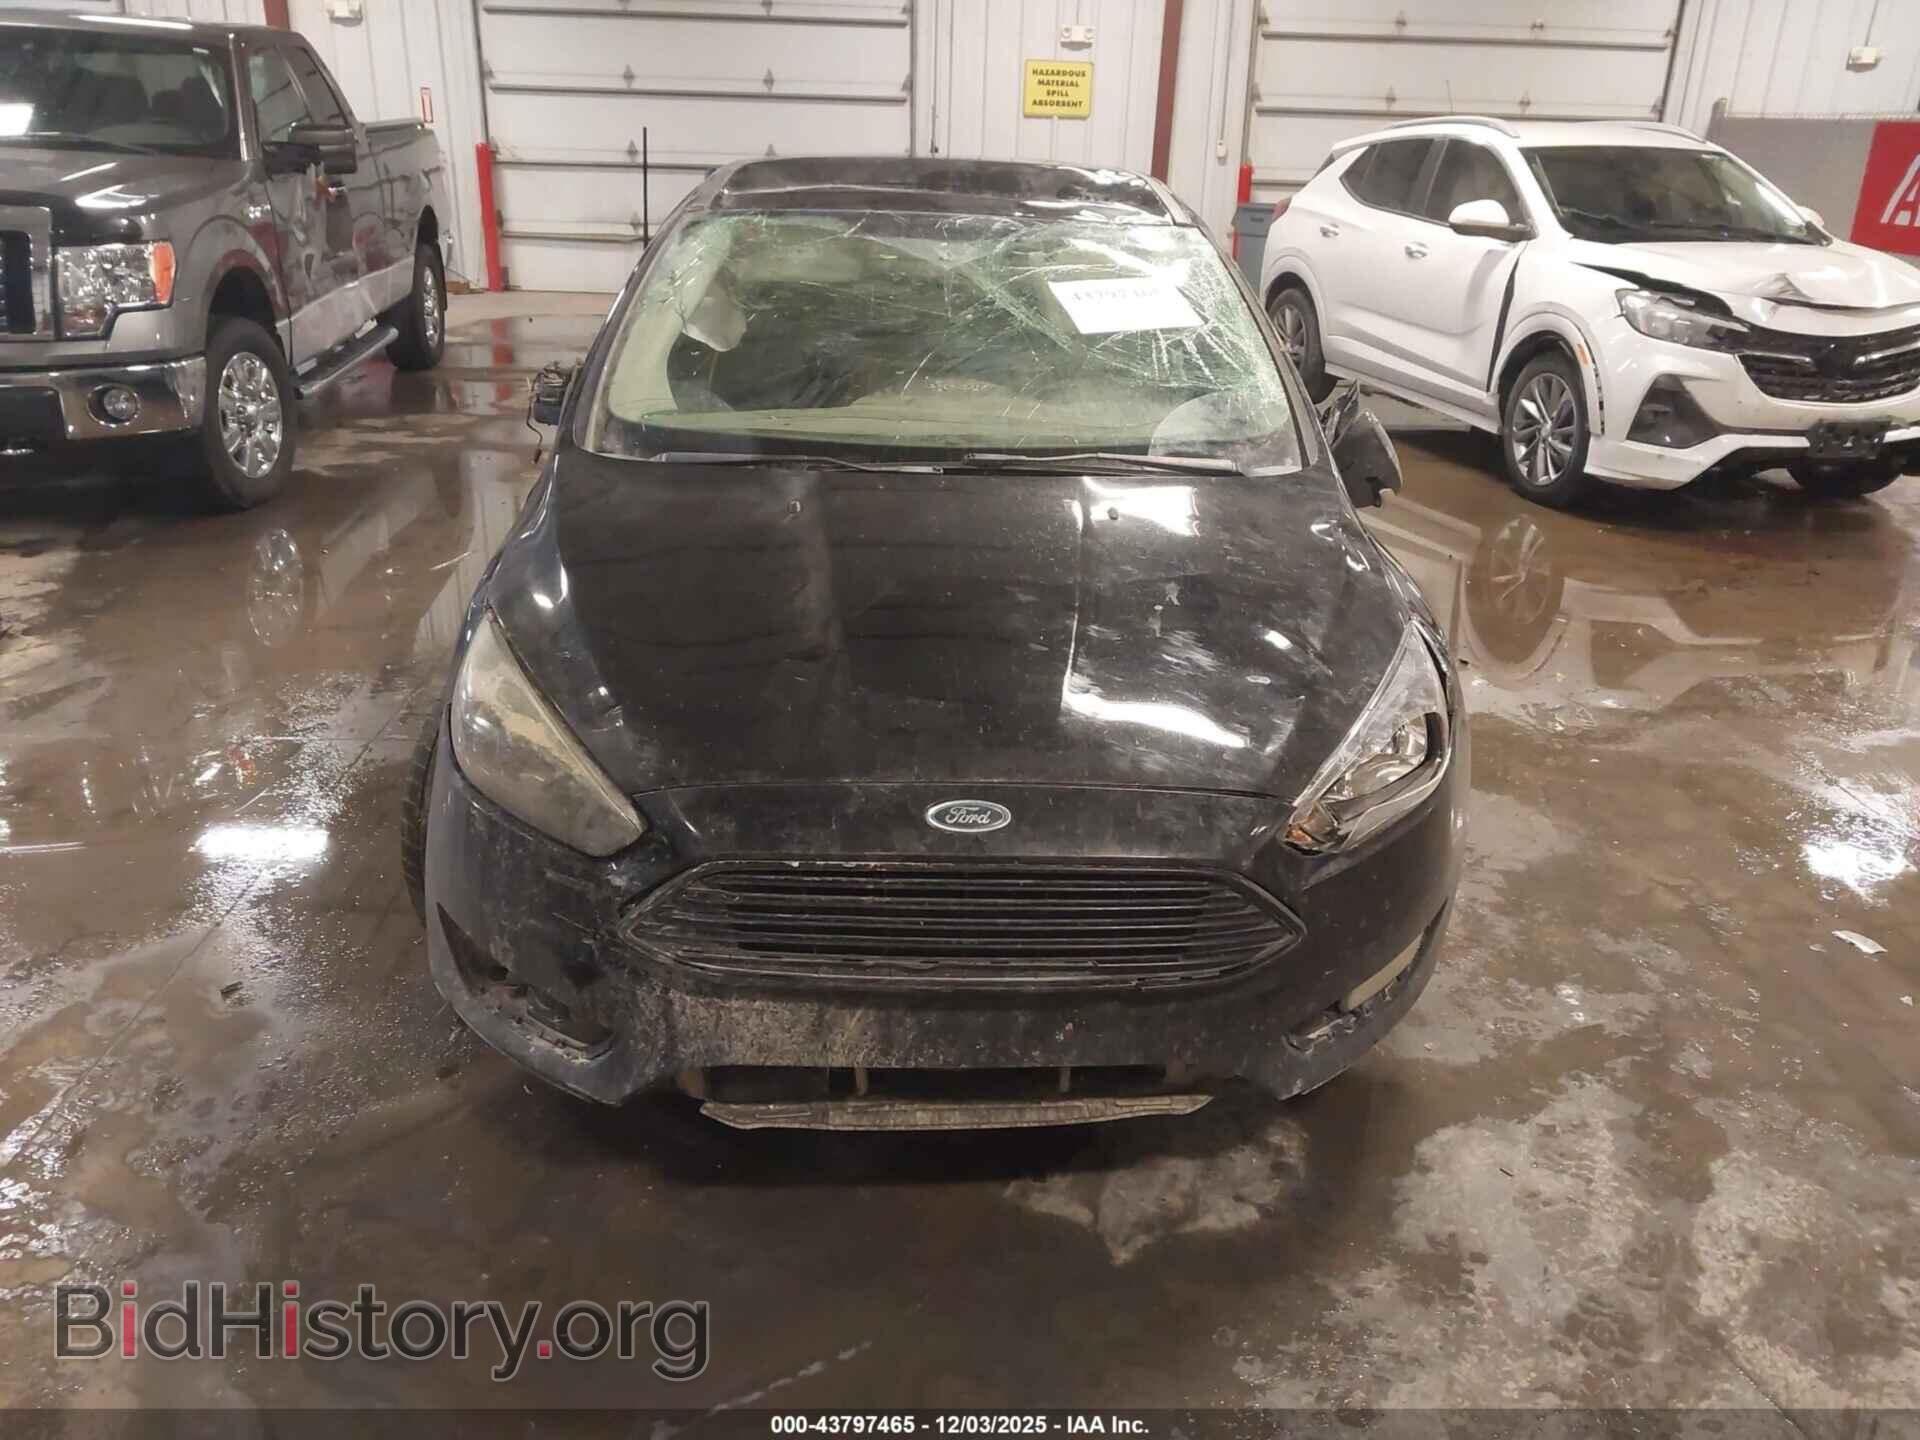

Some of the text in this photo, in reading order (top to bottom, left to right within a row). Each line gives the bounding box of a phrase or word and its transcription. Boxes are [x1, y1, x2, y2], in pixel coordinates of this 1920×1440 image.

[1032, 68, 1086, 77] HAZARDOUS
[1037, 78, 1080, 88] MATERIAL
[1046, 89, 1069, 97] SPILL
[1031, 98, 1083, 108] ABSORBENT
[945, 805, 992, 824] Ford
